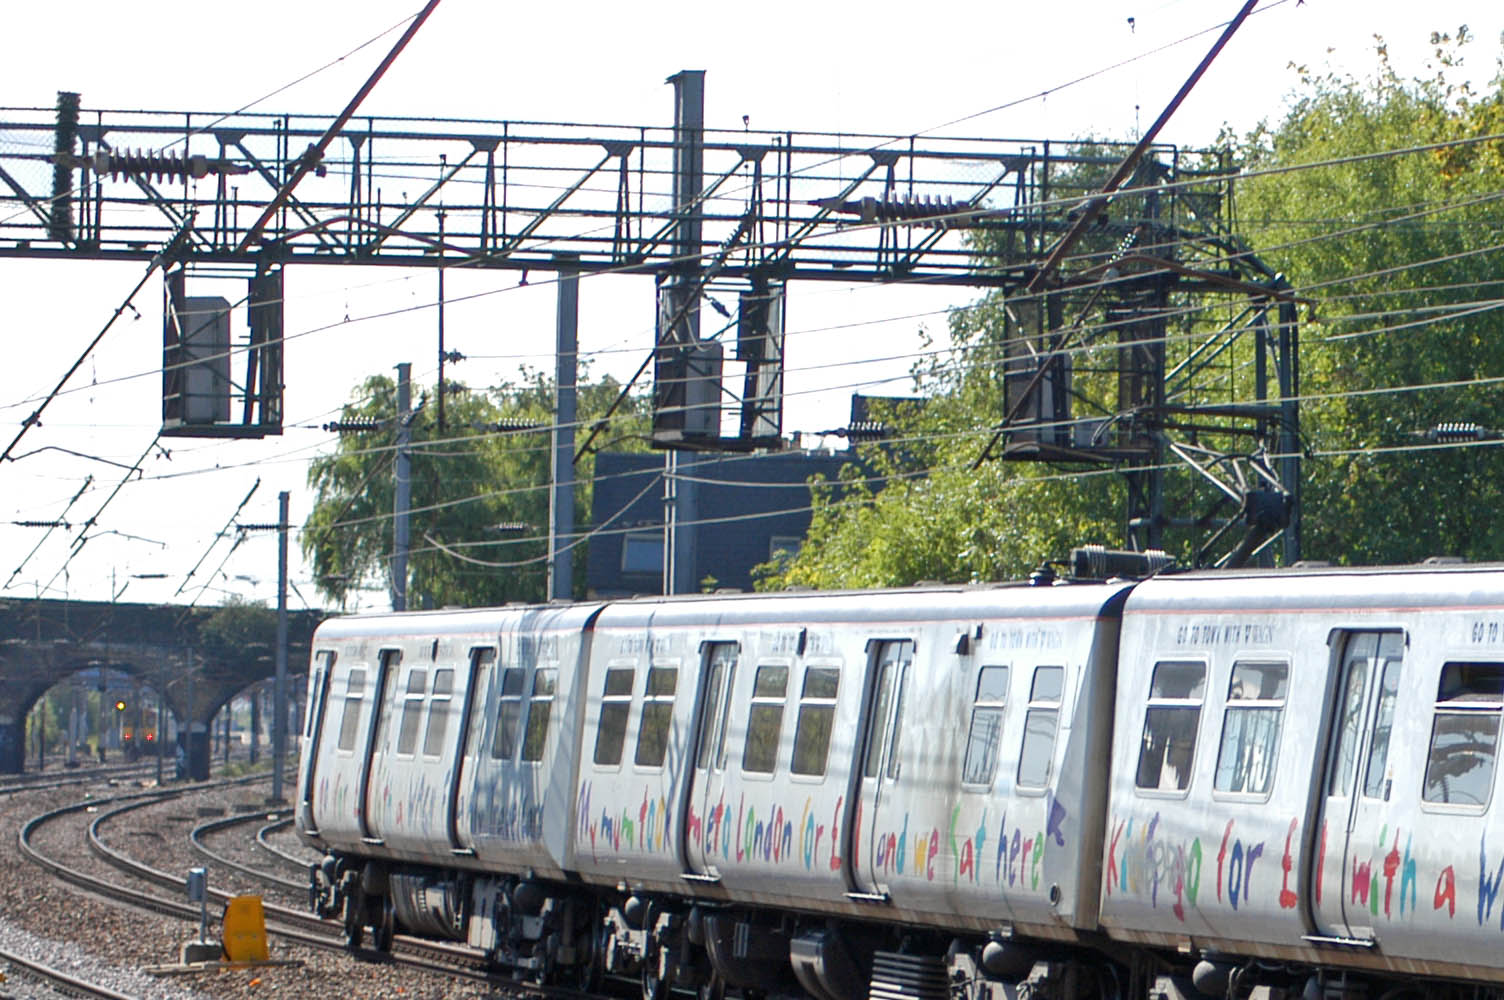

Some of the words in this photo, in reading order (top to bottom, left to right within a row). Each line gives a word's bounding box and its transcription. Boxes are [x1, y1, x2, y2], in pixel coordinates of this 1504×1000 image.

[736, 791, 792, 865] London
[799, 795, 824, 873] for
[876, 811, 909, 875] and
[914, 828, 939, 881] we
[996, 810, 1044, 892] here
[1216, 818, 1265, 912] for
[1350, 823, 1417, 920] with
[1434, 864, 1456, 919] a
